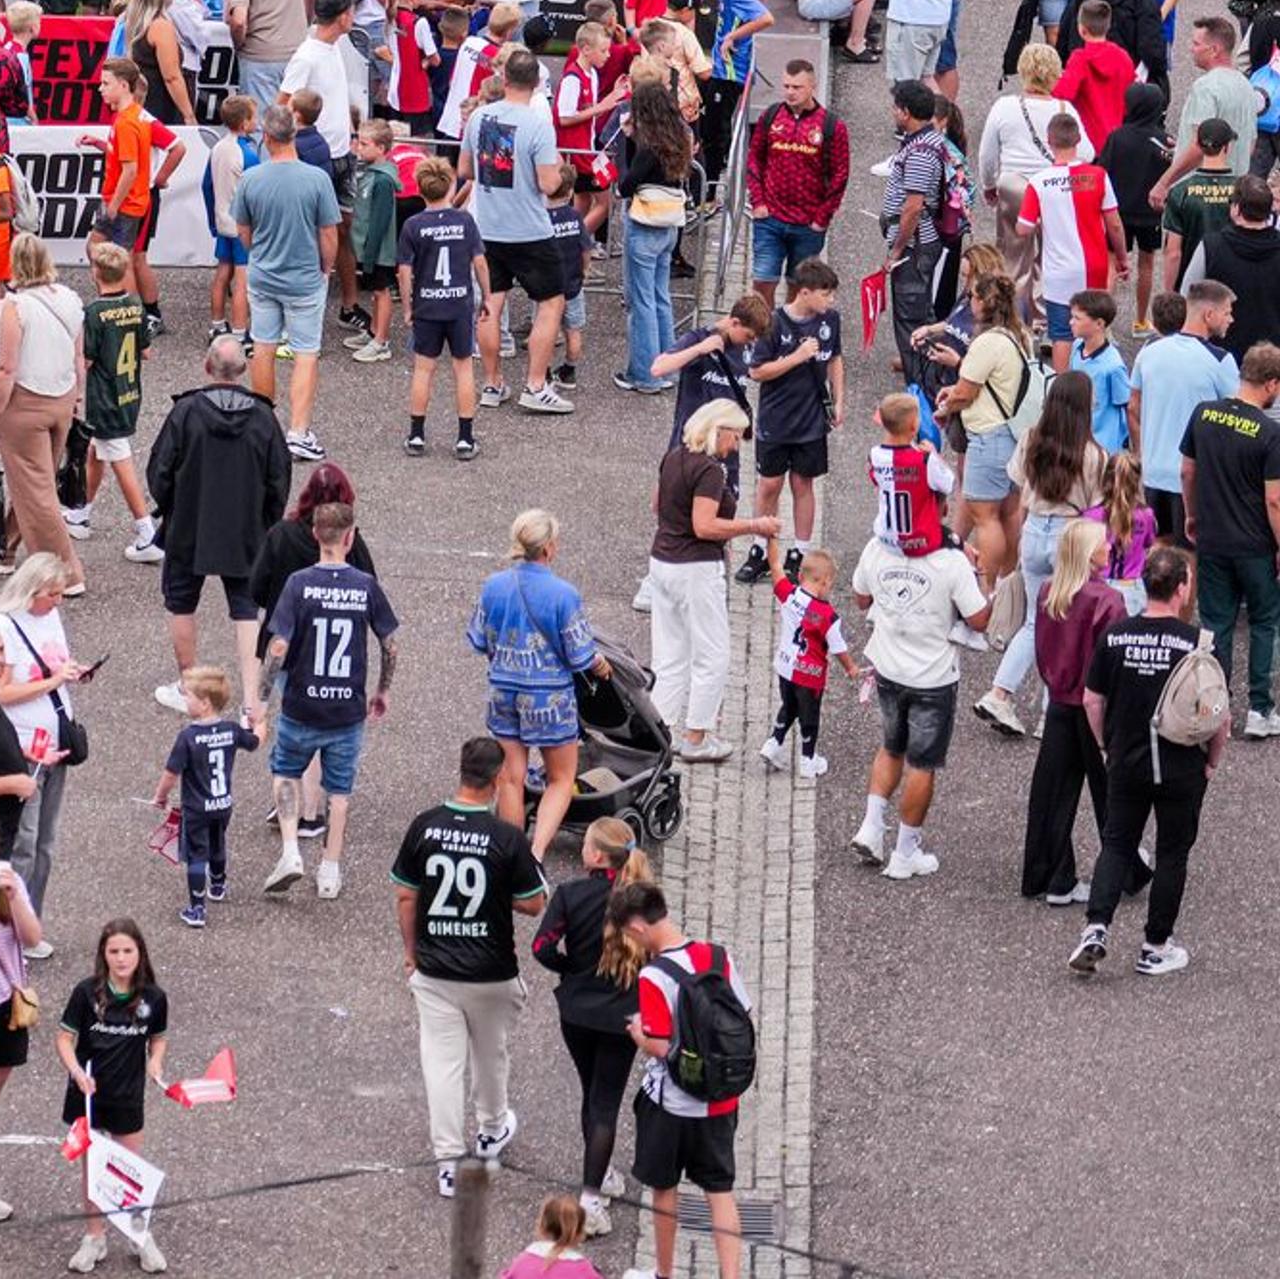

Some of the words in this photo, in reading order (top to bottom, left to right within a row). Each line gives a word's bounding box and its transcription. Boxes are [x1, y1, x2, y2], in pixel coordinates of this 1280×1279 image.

[434, 245, 452, 287] 4
[420, 286, 468, 299] SCHOUTEN
[117, 332, 136, 383] 4
[313, 618, 353, 679] 12
[209, 749, 227, 797] 3
[425, 854, 487, 918] 29
[428, 921, 489, 938] GIMENEZ
